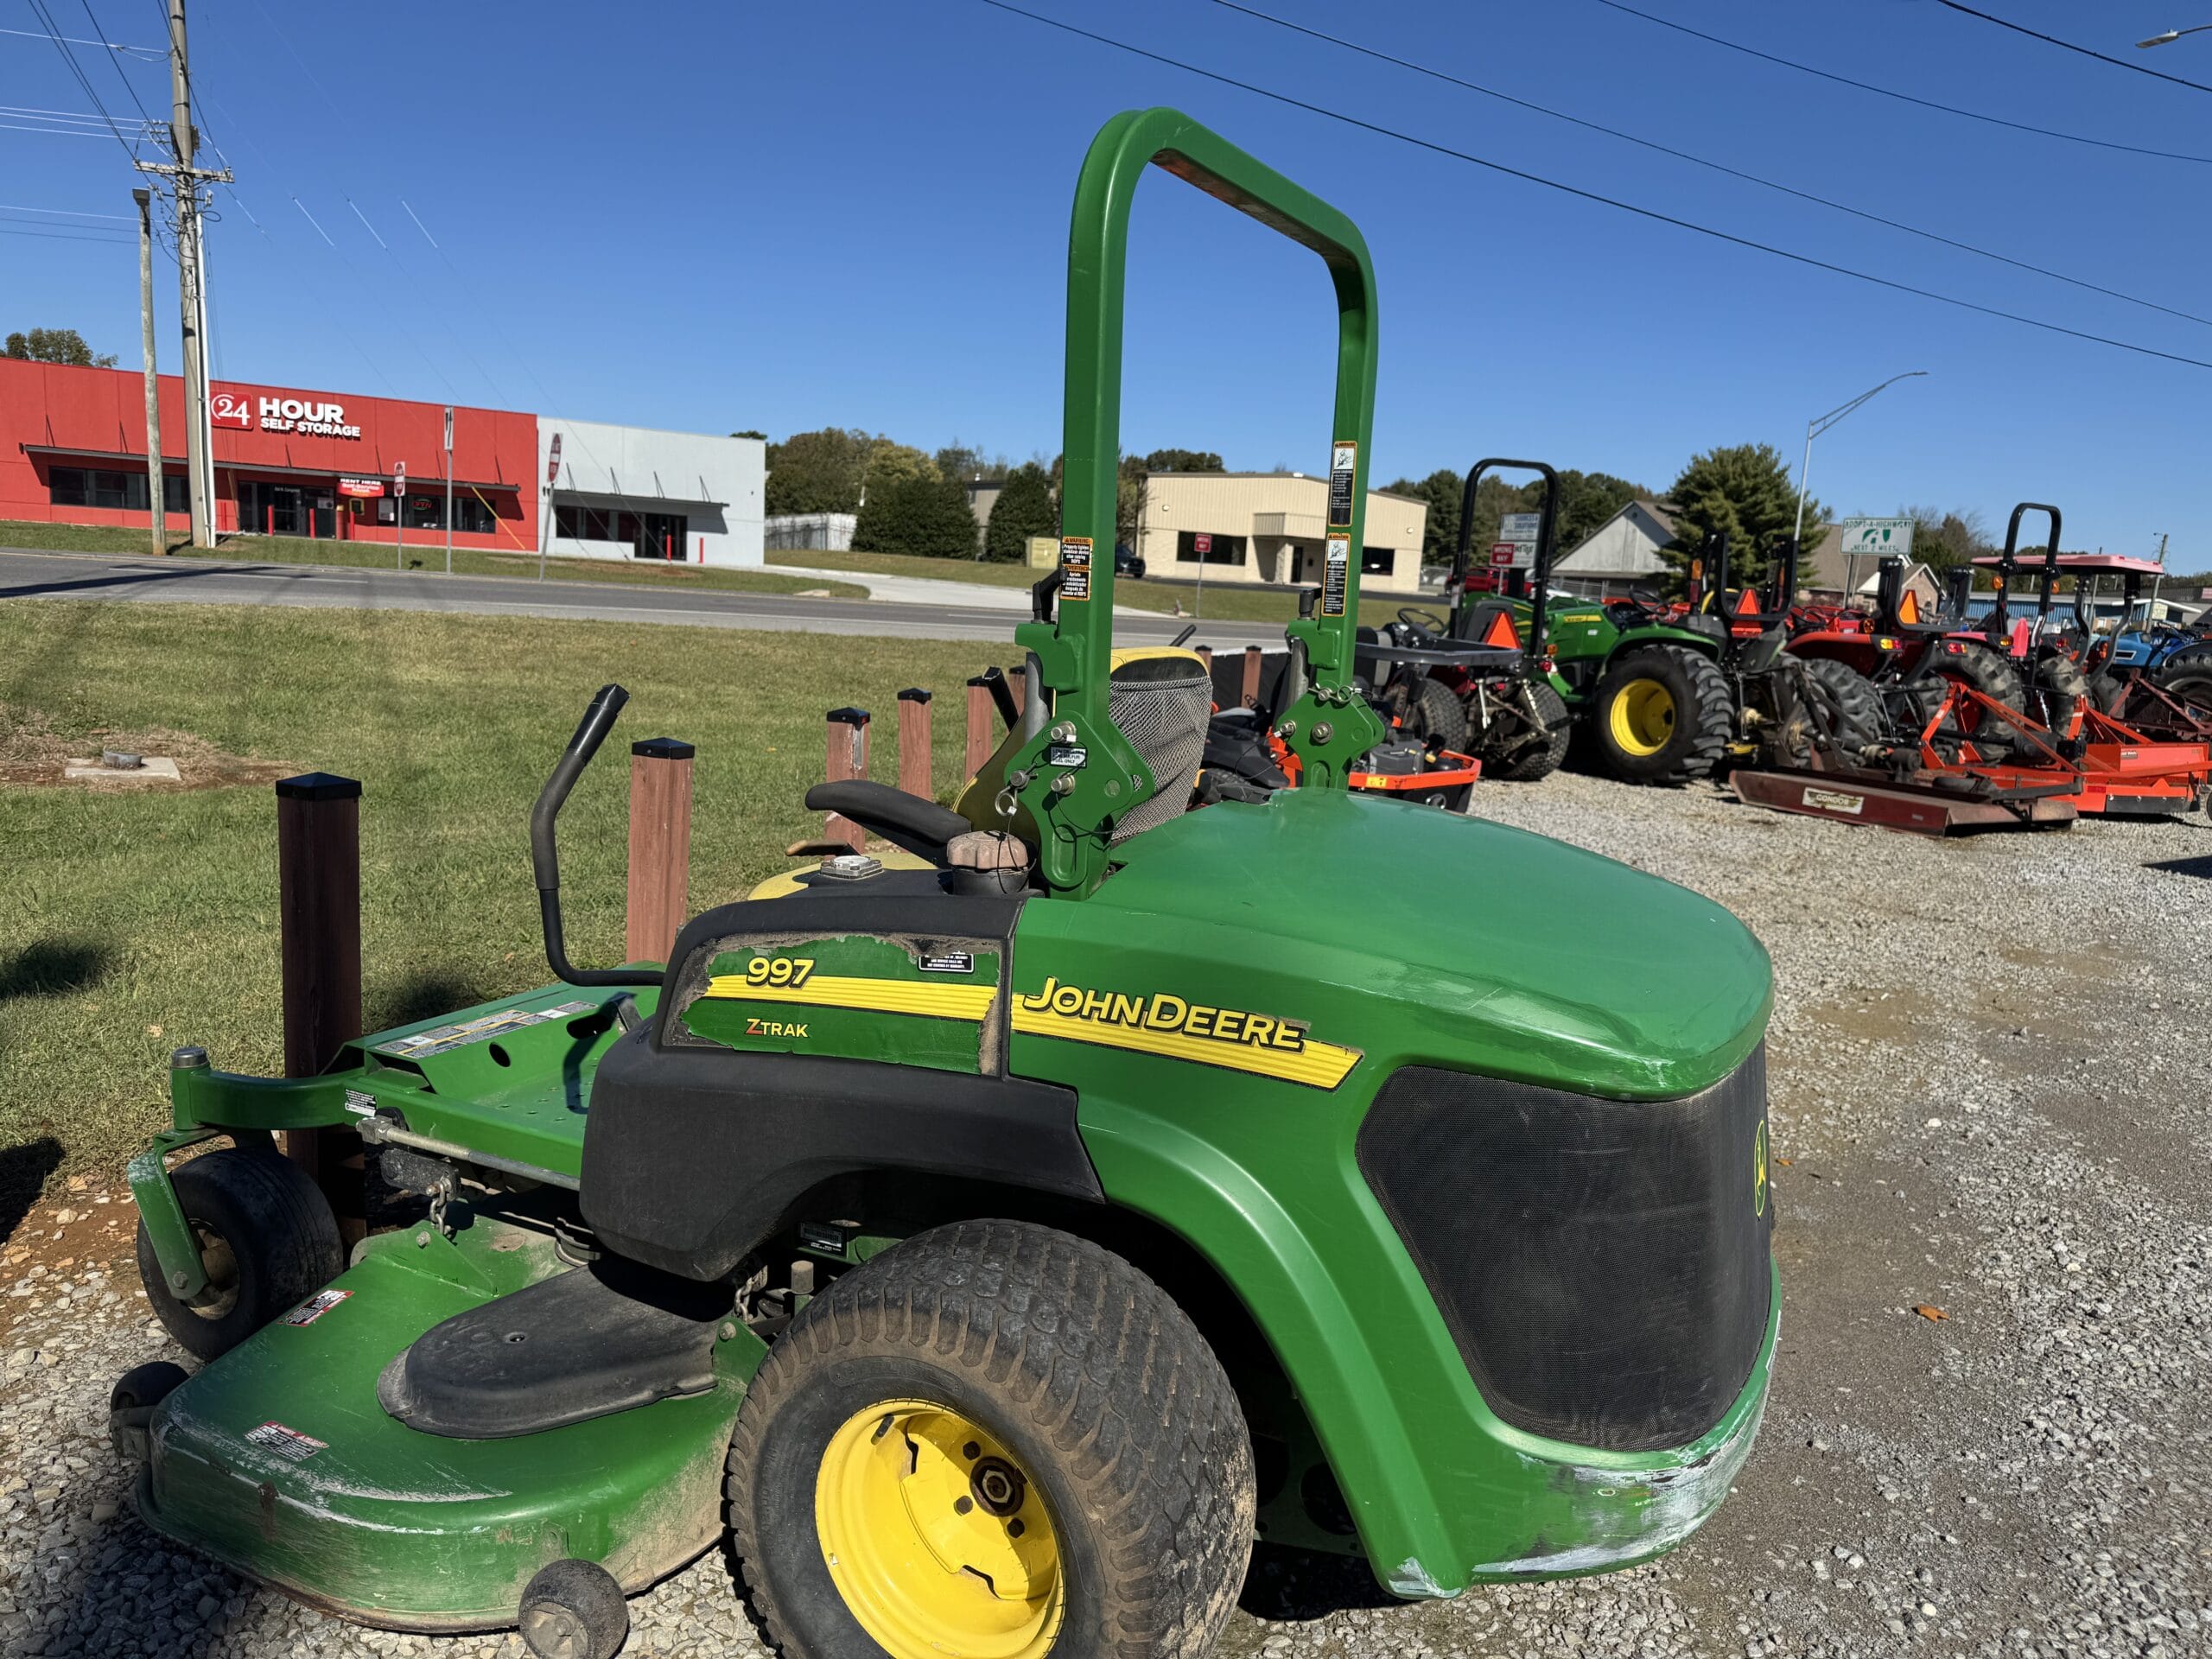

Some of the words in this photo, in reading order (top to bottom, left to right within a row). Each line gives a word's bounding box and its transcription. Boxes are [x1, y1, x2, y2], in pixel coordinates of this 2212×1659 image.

[217, 397, 251, 426] 24
[259, 397, 344, 423] HOUR
[260, 417, 294, 430] SELF
[297, 421, 360, 437] STORAGE
[747, 957, 815, 985] 997
[1023, 976, 1147, 1027] JOHN
[1145, 993, 1305, 1052] DEERE
[746, 1018, 809, 1038] ZTRAK
